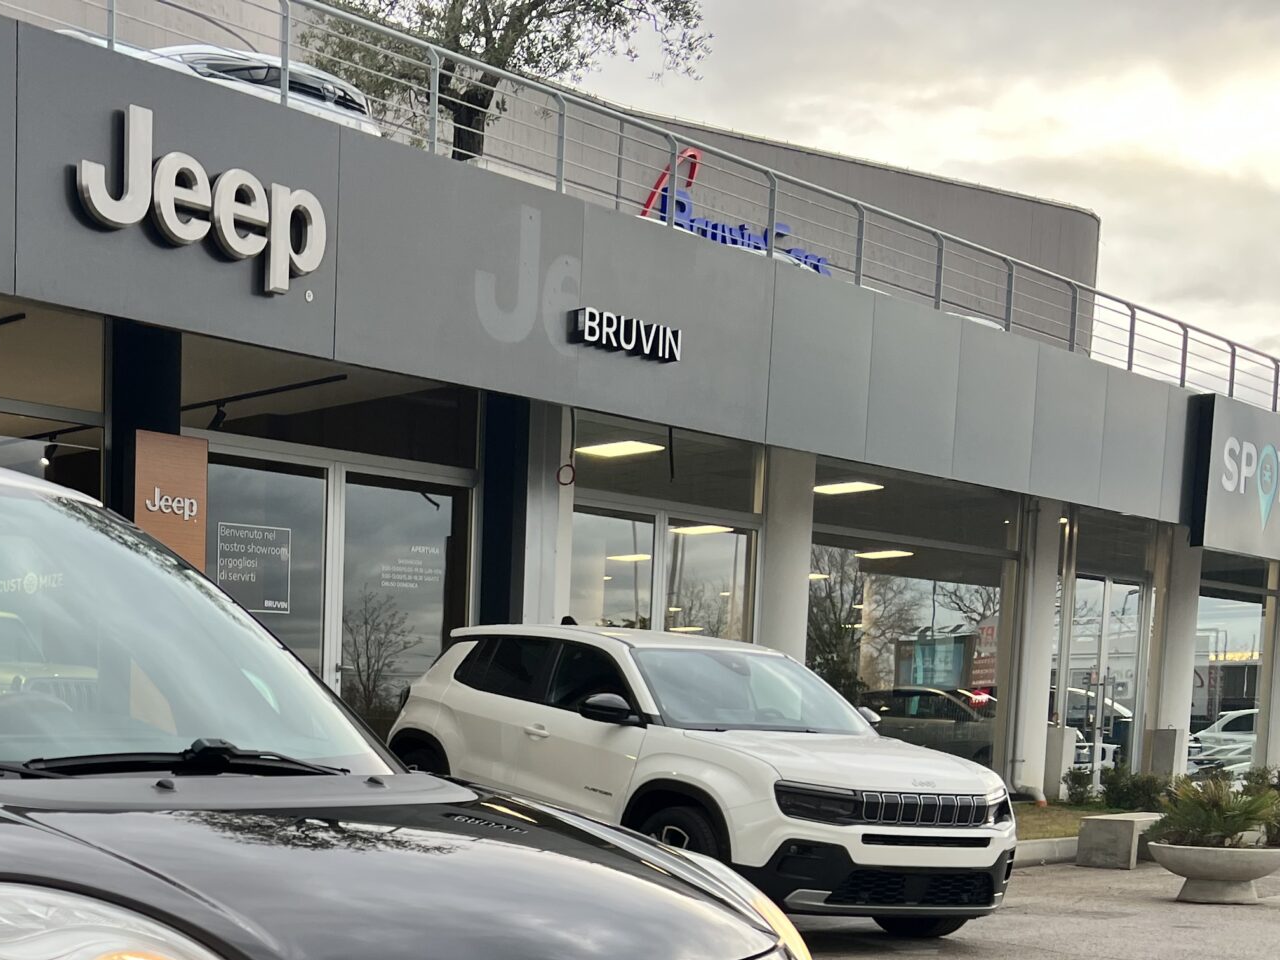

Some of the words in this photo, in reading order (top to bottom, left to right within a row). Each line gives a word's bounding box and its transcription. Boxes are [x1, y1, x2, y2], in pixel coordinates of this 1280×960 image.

[77, 104, 326, 294] Jeep
[584, 307, 682, 362] BRUVIN
[145, 486, 198, 521] Jeep
[220, 525, 263, 541] Benvenuto
[264, 530, 276, 541] nel
[220, 542, 246, 553] nostro
[220, 556, 258, 569] orgogliosi
[220, 570, 228, 581] di
[229, 571, 256, 582] servirti
[264, 599, 288, 609] BRUVIN
